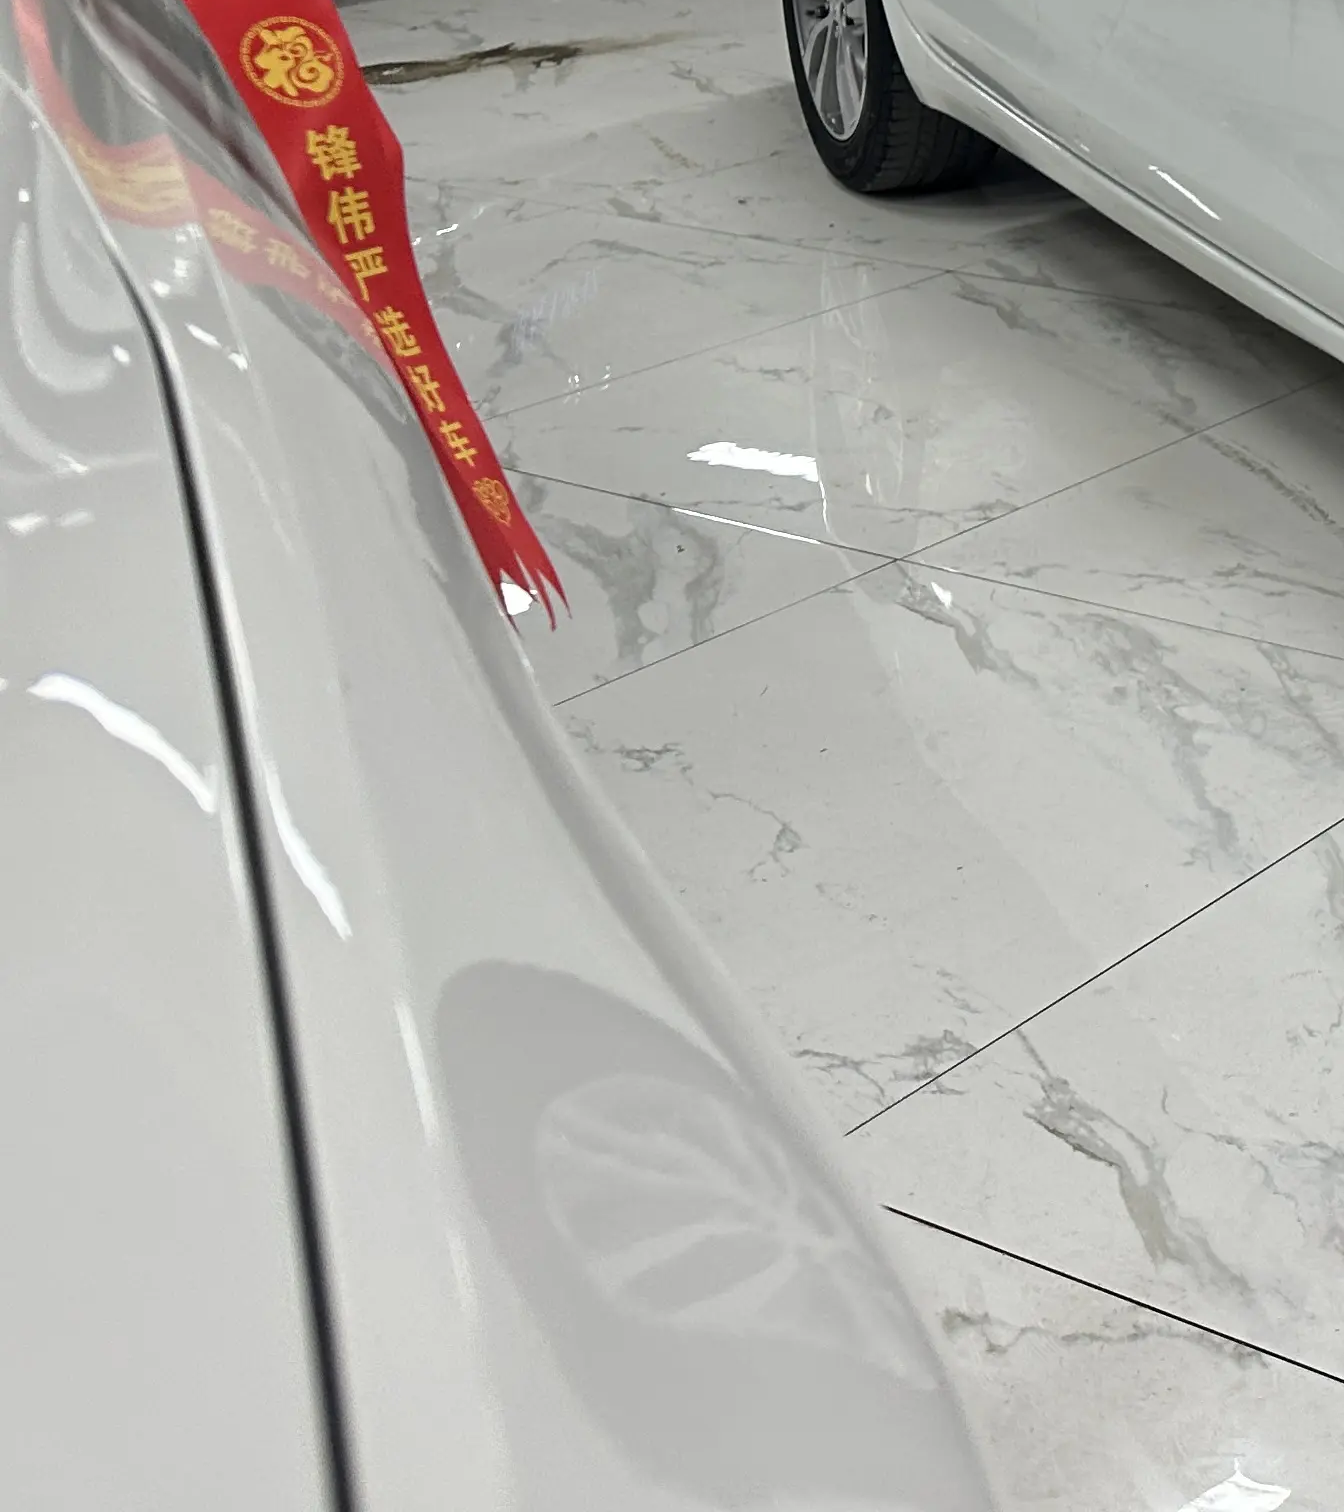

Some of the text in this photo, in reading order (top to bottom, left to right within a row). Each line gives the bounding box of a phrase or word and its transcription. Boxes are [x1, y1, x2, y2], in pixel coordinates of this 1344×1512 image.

[305, 125, 479, 467] 锋伟严选好车
